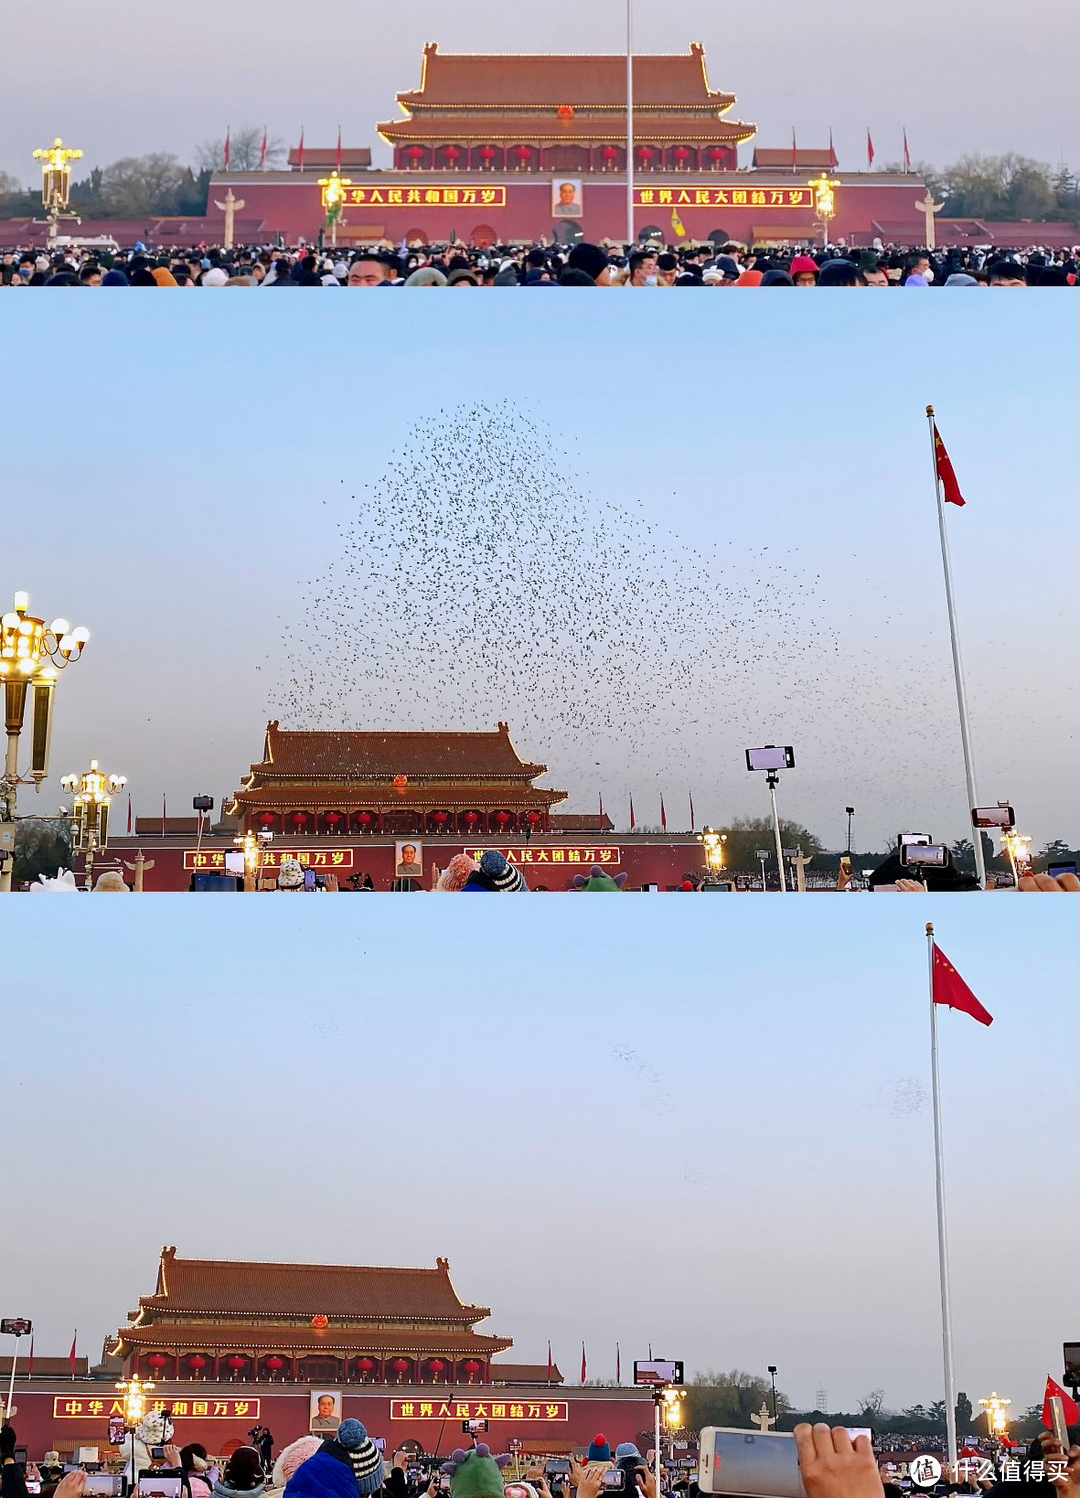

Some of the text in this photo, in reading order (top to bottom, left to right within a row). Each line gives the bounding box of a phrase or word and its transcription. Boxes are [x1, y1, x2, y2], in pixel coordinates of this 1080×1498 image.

[639, 190, 803, 204] 世界人民大团结万岁
[193, 852, 345, 866] 中华共和国万岁
[473, 849, 613, 862] 世人民大团结万岁
[65, 1400, 249, 1415] 中华人共和国万岁
[401, 1403, 559, 1418] 世界人民大团结万岁
